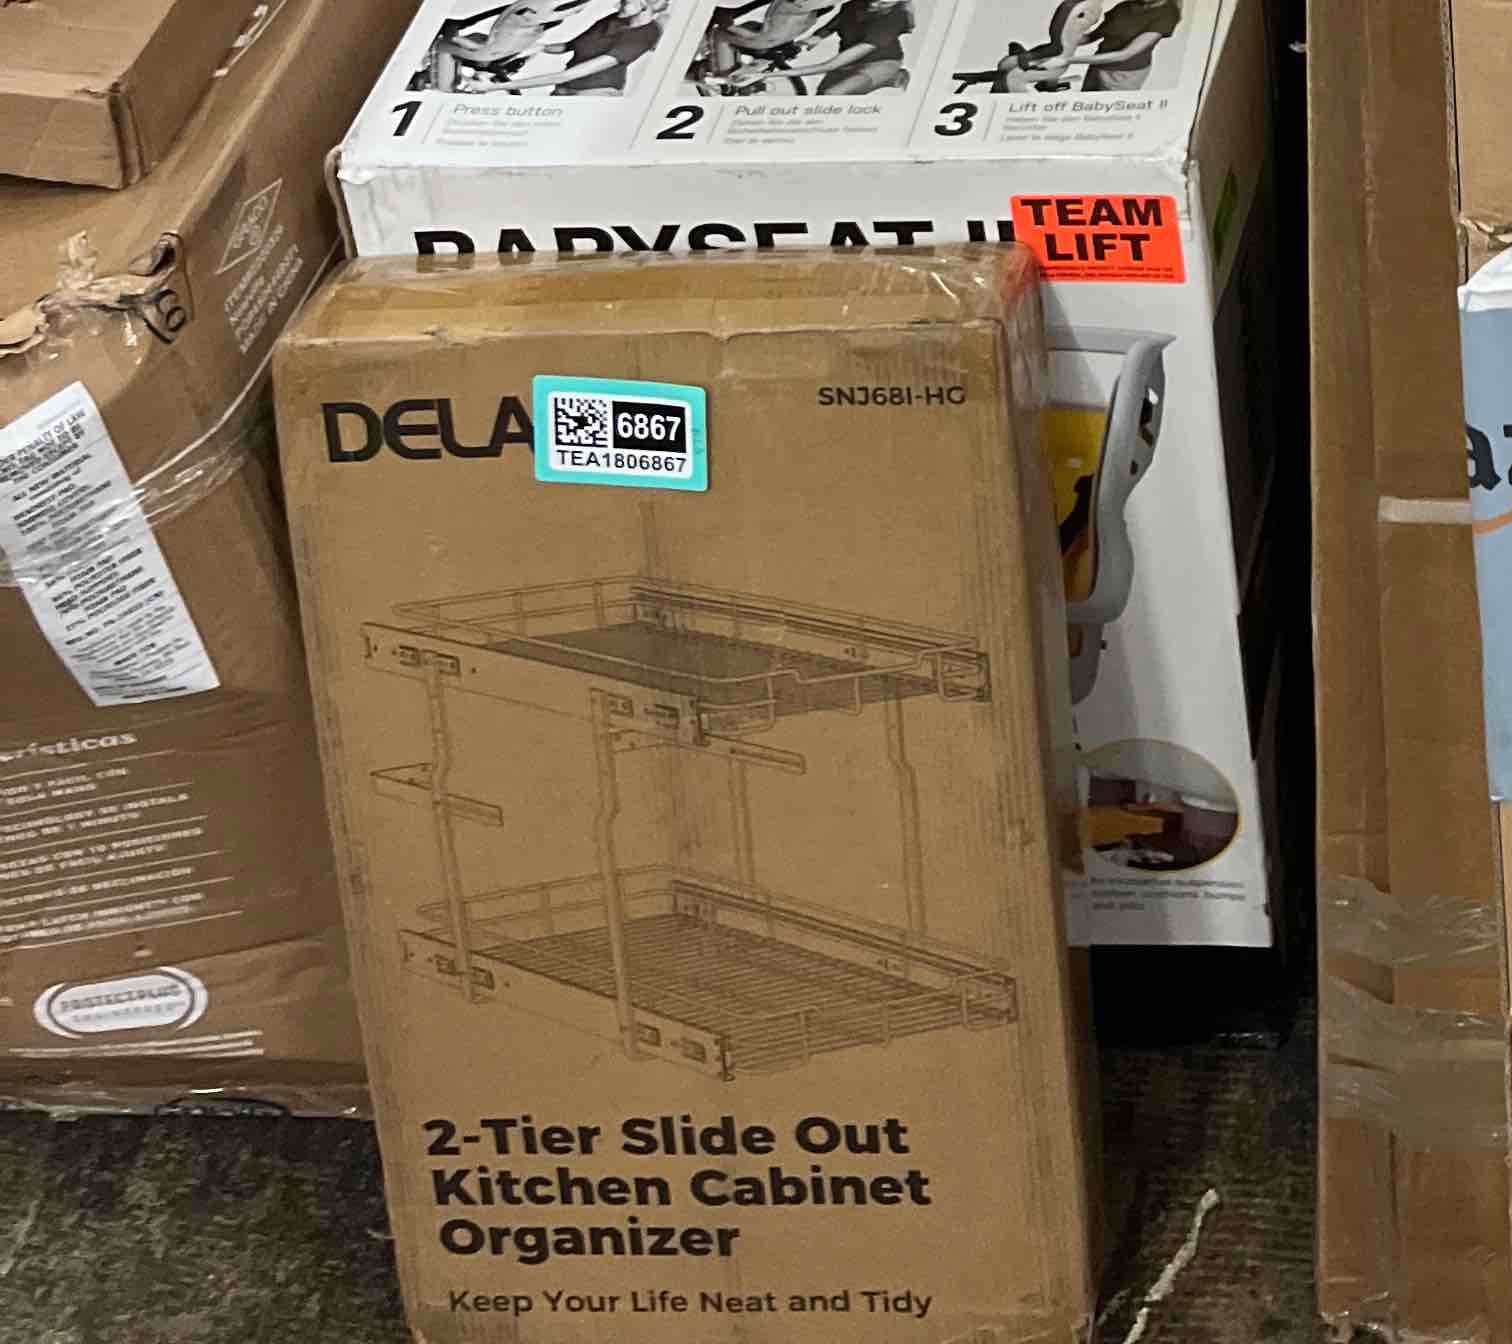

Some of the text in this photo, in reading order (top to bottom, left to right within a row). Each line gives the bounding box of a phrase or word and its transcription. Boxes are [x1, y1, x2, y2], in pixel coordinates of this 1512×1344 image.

[391, 101, 422, 137] 1
[453, 103, 564, 117] Press button
[735, 104, 881, 116] Pull out slide lock
[934, 101, 978, 137] 3
[1009, 100, 1038, 112] Lift
[1043, 100, 1067, 112] off
[1072, 99, 1154, 114] BabySeat
[656, 104, 704, 140] 2
[1020, 198, 1164, 227] TEAM
[1043, 233, 1152, 263] LIFT
[321, 396, 536, 464] DELA
[616, 413, 682, 442] 6867
[556, 449, 687, 474] TEA1806867
[424, 1114, 910, 1157] 2-Tier Slide Out
[432, 1165, 933, 1208] Kitchen Cabinet
[438, 1216, 741, 1266] Organizer
[448, 1290, 934, 1319] Keep Your Life Neat and Tidy
